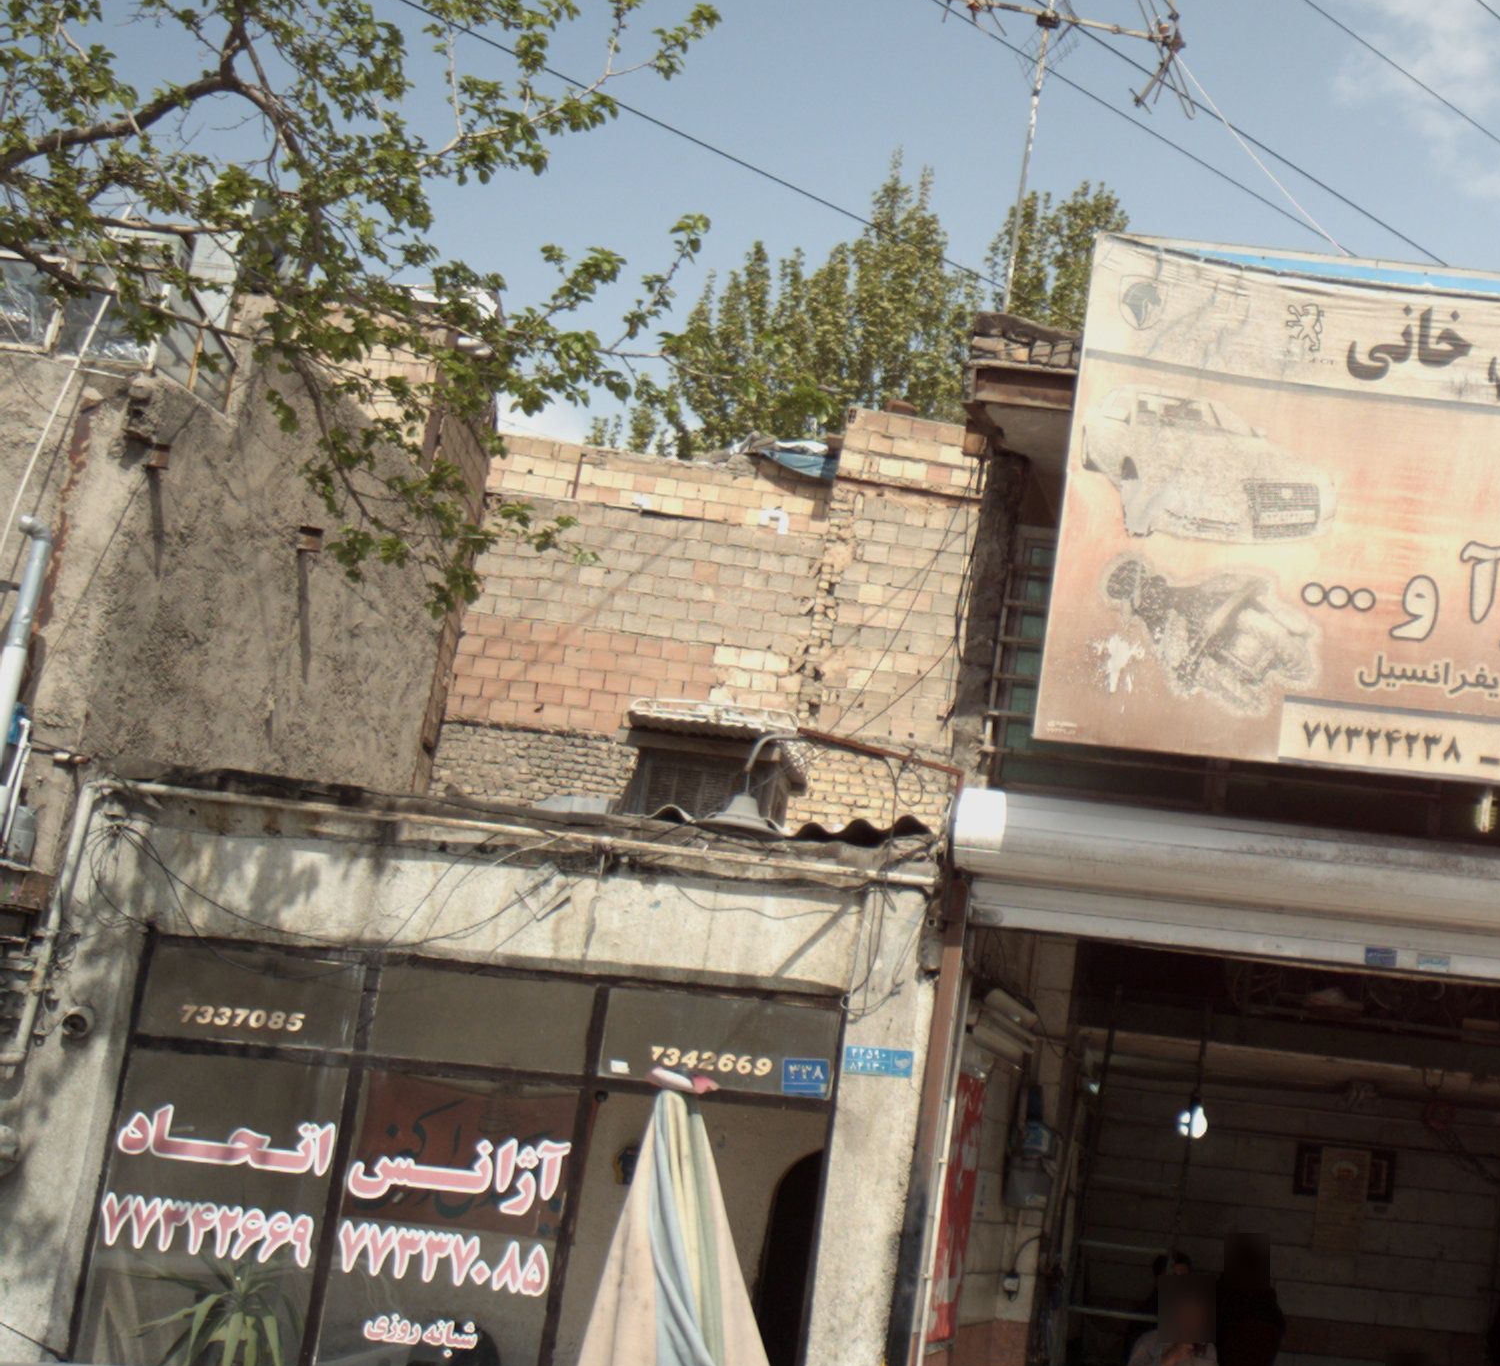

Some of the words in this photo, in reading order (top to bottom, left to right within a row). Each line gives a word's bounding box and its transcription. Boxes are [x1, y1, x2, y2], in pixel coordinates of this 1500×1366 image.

[1346, 303, 1474, 381] خانی
[1388, 574, 1441, 643] و
[180, 1004, 306, 1032] 7337085
[651, 1046, 773, 1076] 7342669
[117, 1104, 336, 1177] اتحاد
[348, 1137, 572, 1216] آژانس
[363, 1313, 422, 1345] روزی
[422, 1319, 478, 1358] شبانه
